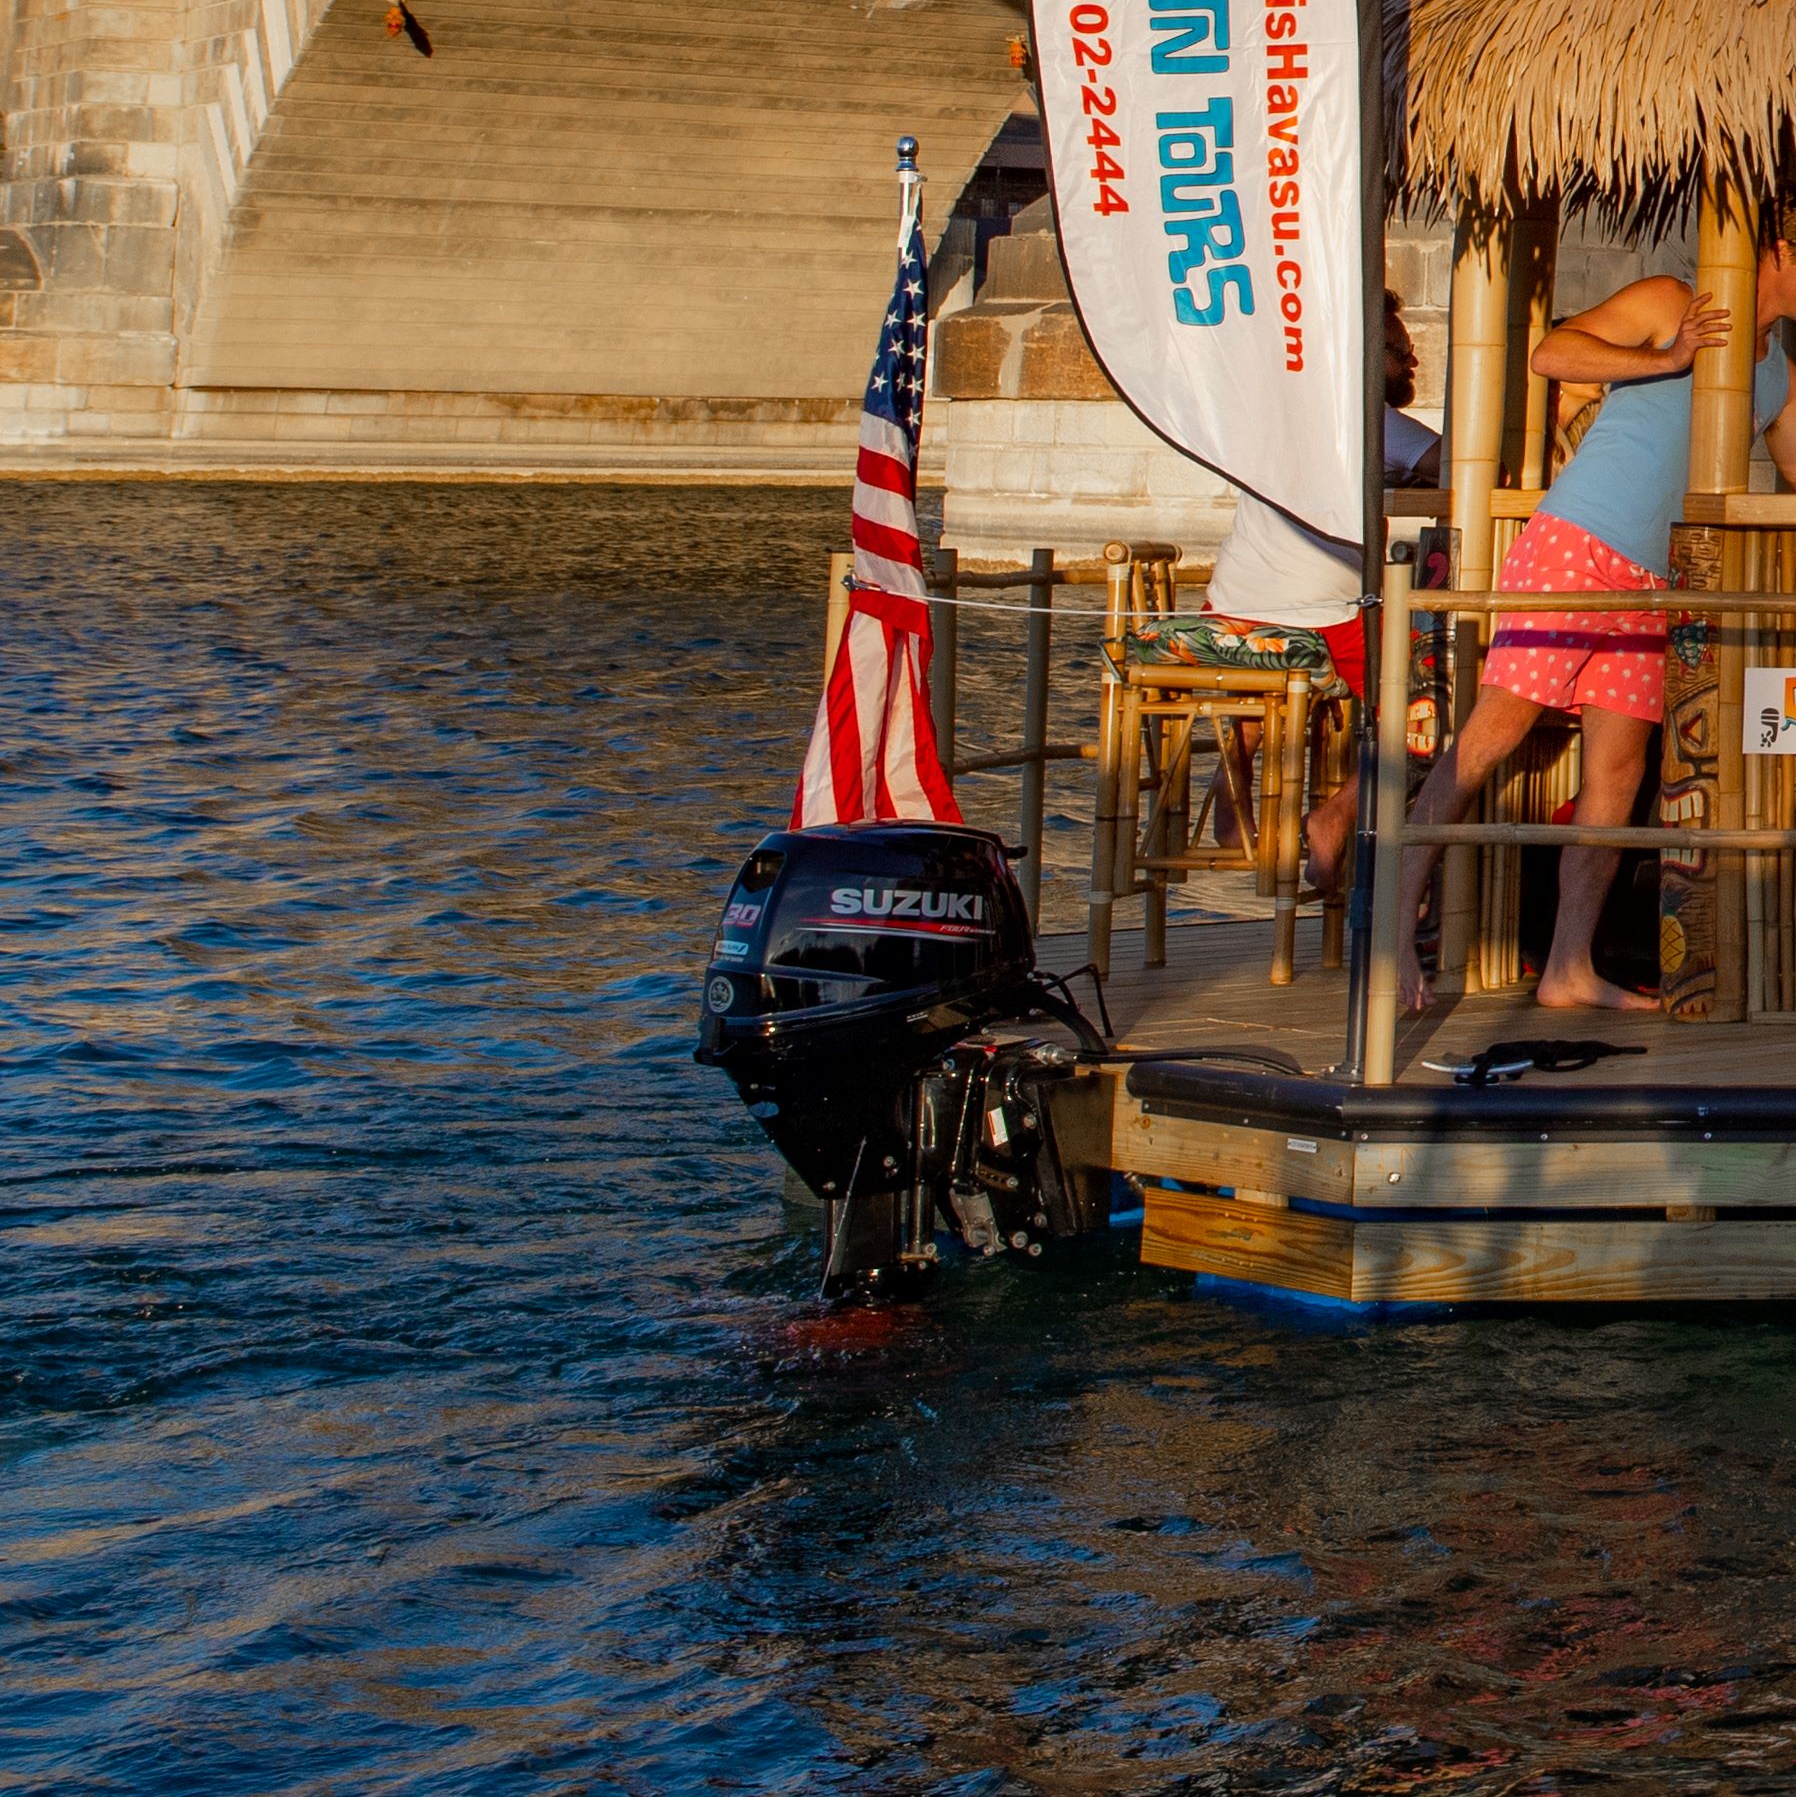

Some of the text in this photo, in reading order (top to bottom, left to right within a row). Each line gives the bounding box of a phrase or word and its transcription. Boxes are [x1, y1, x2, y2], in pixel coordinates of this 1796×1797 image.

[1156, 96, 1256, 327] TOURS
[722, 903, 761, 928] 30
[830, 887, 984, 920] SUZUKI
